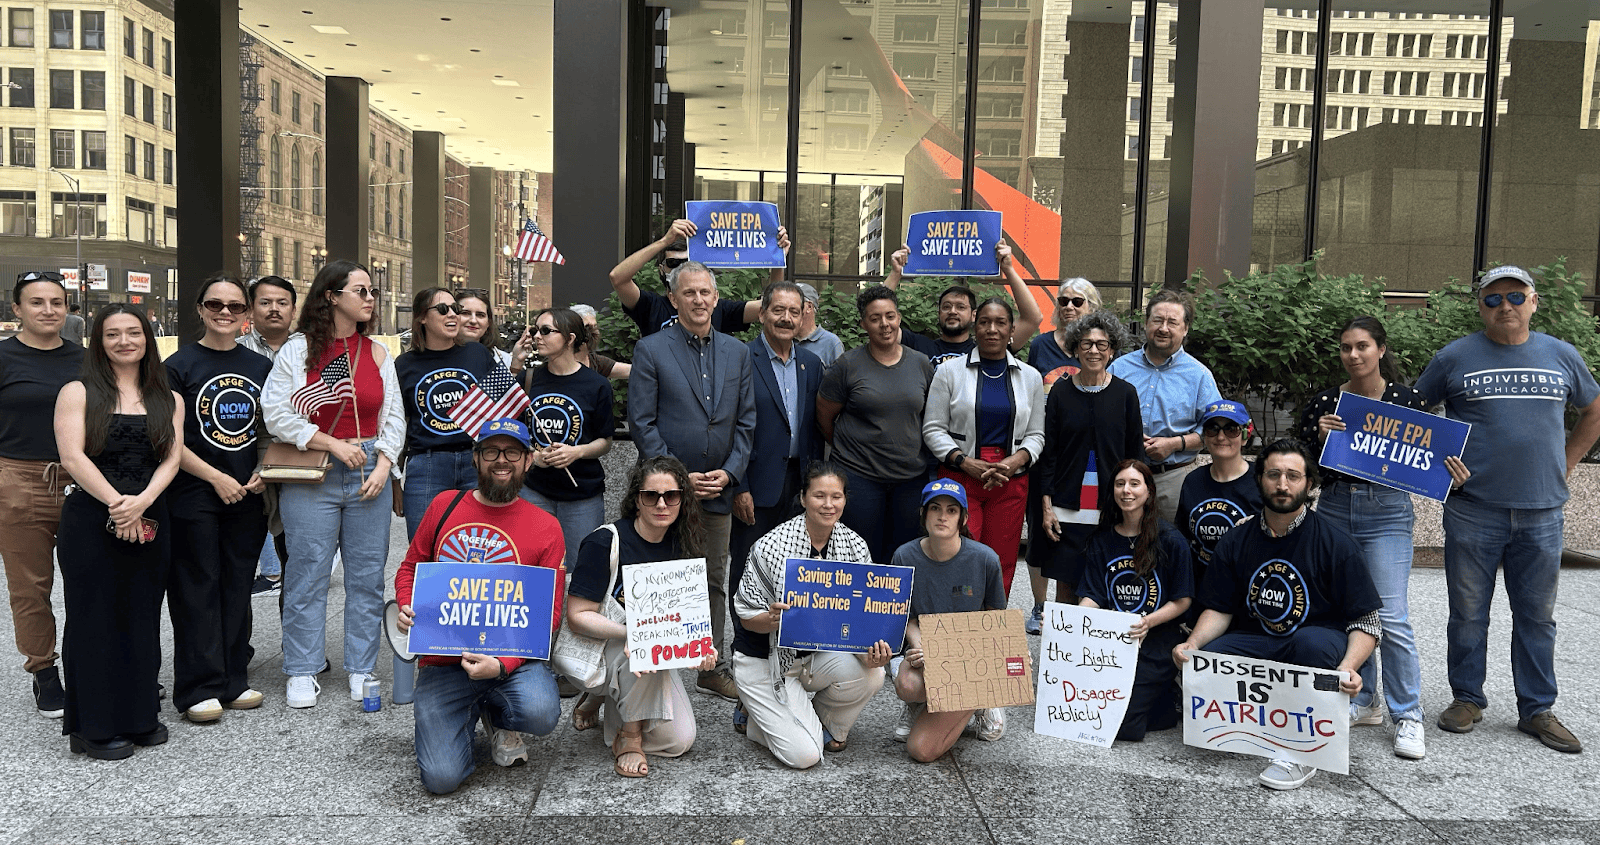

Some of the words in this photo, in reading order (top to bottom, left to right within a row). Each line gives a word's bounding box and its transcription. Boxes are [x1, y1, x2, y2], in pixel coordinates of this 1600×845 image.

[710, 212, 738, 229] SAVE
[741, 212, 761, 230] EPA
[927, 222, 955, 238] SAVE
[957, 222, 978, 238] EPA
[706, 230, 734, 248] SAVE
[737, 231, 766, 248] LIVES
[921, 239, 950, 256] SAVE
[952, 239, 983, 256] LIVES
[219, 378, 244, 388] AFGE
[434, 371, 457, 381] AFGE
[1463, 374, 1565, 388] INDIVISIBLE
[418, 389, 426, 407] ACT
[432, 390, 464, 404] NOW
[1484, 386, 1549, 394] CHICAGO
[200, 395, 211, 416] ACT
[219, 402, 251, 414] NOW
[542, 396, 566, 406] AFGE
[430, 419, 460, 431] ORGAN
[536, 418, 564, 429] NOW
[569, 415, 580, 442] UNITE
[1362, 412, 1403, 440] SAVE
[1402, 422, 1433, 449] EPA
[211, 430, 249, 446] ORGANIZE
[1350, 431, 1391, 459] SAVE
[1389, 442, 1434, 471] LIVES
[1205, 502, 1229, 512] AFGE
[1199, 525, 1229, 536] NOW
[457, 533, 503, 548] TOGETHER
[1117, 559, 1135, 570] AFG
[797, 566, 833, 588] Saving
[835, 569, 852, 586] the
[866, 571, 901, 594] Saving
[448, 577, 490, 601] SAVE
[494, 579, 524, 603] EPA
[1115, 584, 1143, 595] NOW
[1146, 577, 1158, 608] UNITE
[786, 591, 810, 608] Civil
[812, 592, 851, 611] Service
[864, 596, 909, 615] America!
[1272, 601, 1284, 609] TIME
[1292, 584, 1304, 618] UNITE
[438, 601, 482, 626] SAVE
[485, 603, 530, 629] LIVES
[934, 611, 1008, 635] ALLOW
[682, 621, 710, 635] TRUTH
[1051, 609, 1074, 634] We
[1082, 615, 1133, 645] Reserve
[631, 648, 647, 660] TO
[651, 636, 714, 666] POWER
[1046, 641, 1074, 663] the
[1082, 646, 1118, 673] Right
[940, 658, 1004, 685] STOP
[1043, 669, 1059, 685] to
[1192, 654, 1309, 688] DISSENT
[928, 677, 1033, 711] RETALIATION
[1062, 680, 1126, 710] Disagee
[1237, 680, 1273, 704] IS
[1047, 703, 1103, 730] Publicly
